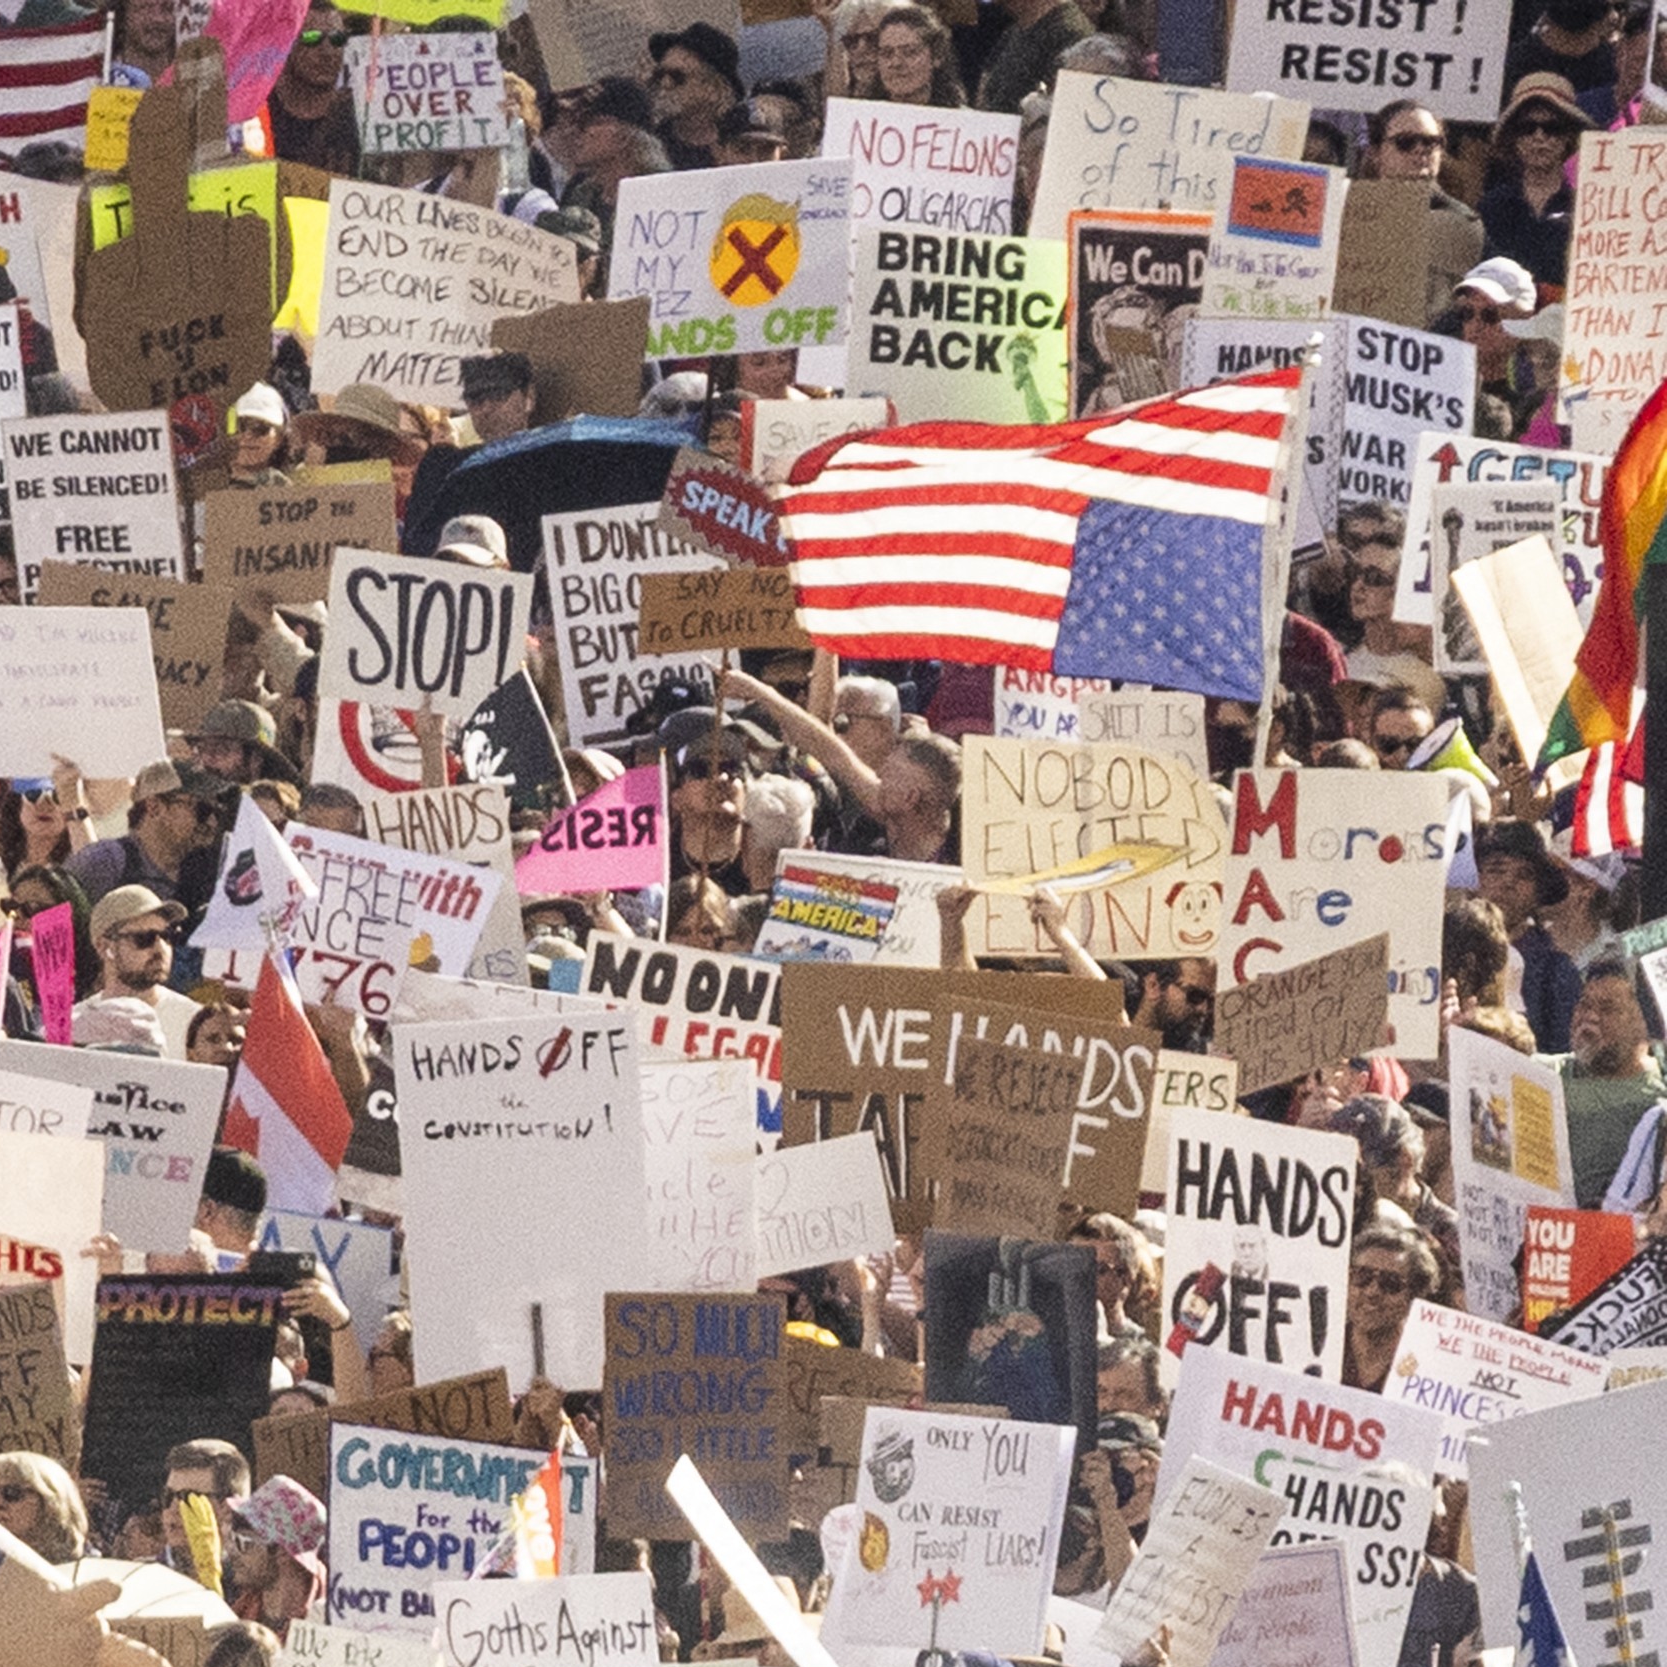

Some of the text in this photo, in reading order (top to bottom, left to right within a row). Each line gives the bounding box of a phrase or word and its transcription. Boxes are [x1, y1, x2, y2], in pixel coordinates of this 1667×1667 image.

[383, 93, 475, 118] OVER
[877, 234, 1026, 279] BRING
[870, 327, 1002, 371] BACK
[10, 428, 161, 458] WE CANNOT
[17, 473, 168, 498] BE SILENCED!
[55, 527, 130, 553] FREE
[346, 567, 512, 693] STOP!
[412, 1038, 520, 1081] HANDS
[1176, 1139, 1346, 1248] HANDS
[1527, 1218, 1575, 1251] YOU
[1529, 1252, 1571, 1281] ARE
[99, 1286, 277, 1325] PROTECT
[1221, 1379, 1385, 1459] HANDS
[928, 1422, 1029, 1475] ONLY YOU
[898, 1503, 1001, 1529] CAN RESIST
